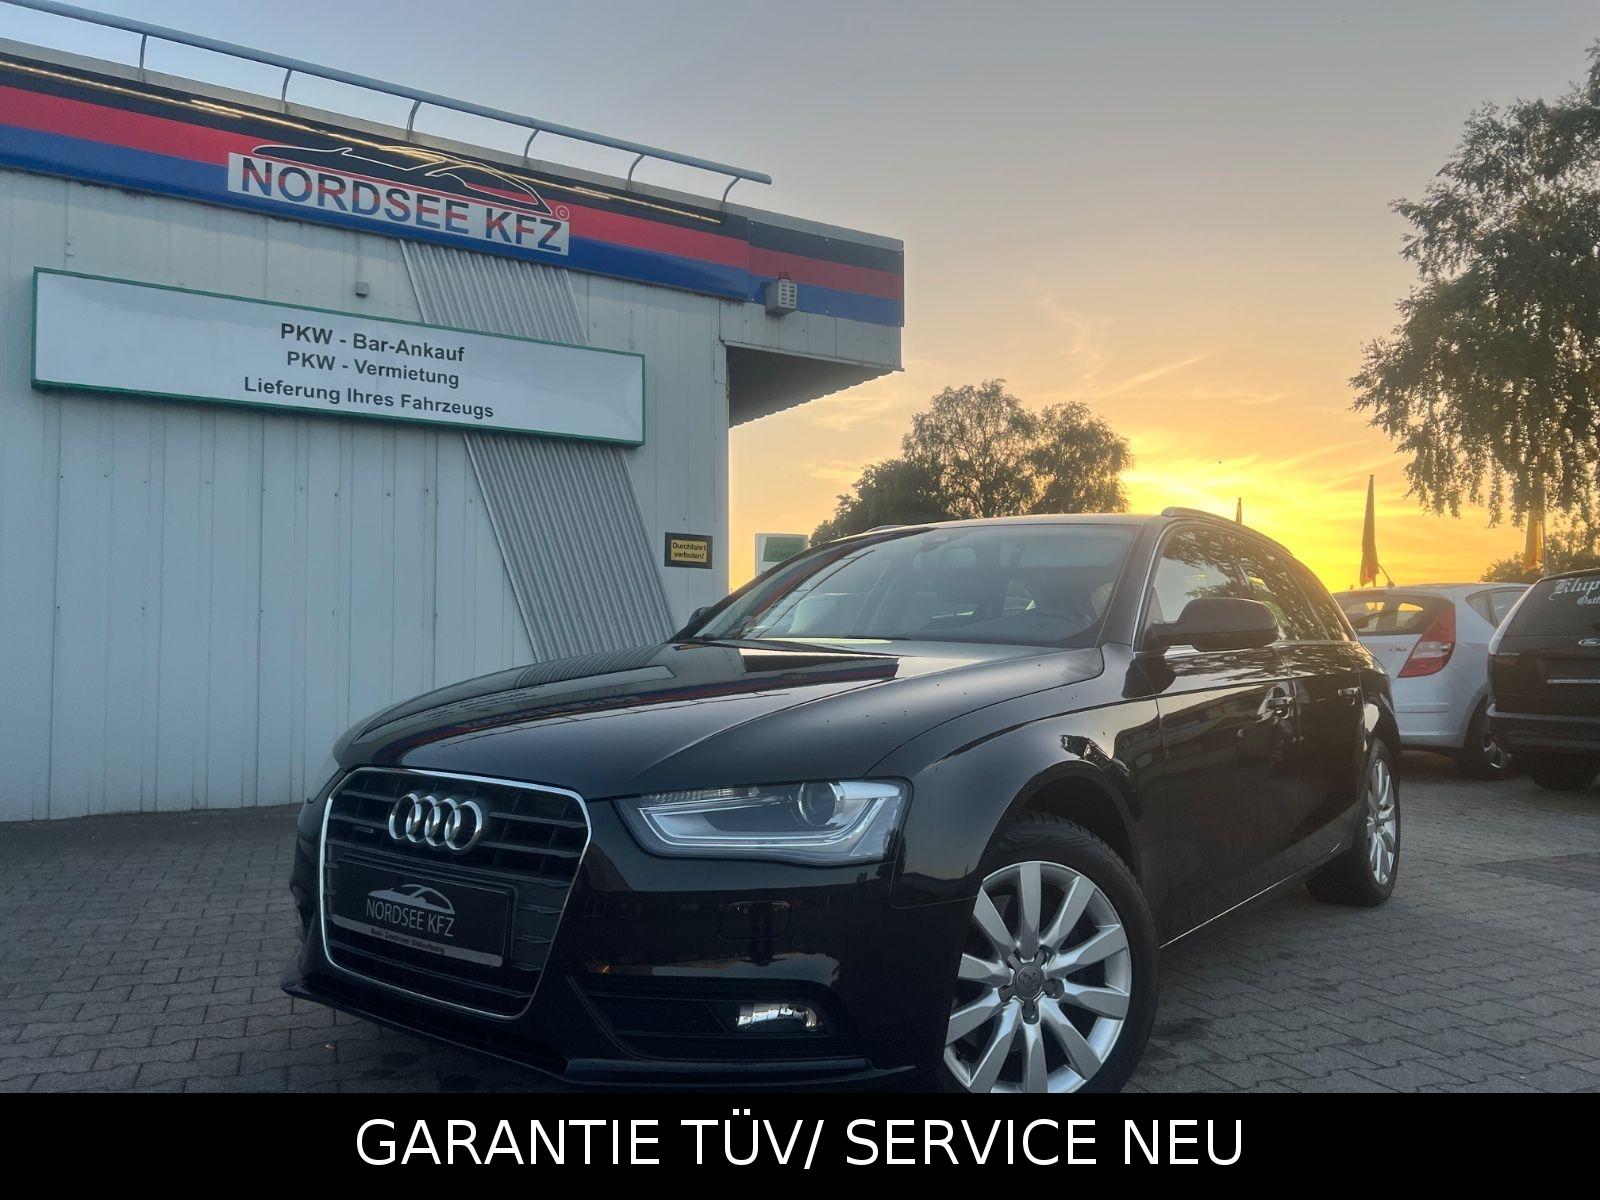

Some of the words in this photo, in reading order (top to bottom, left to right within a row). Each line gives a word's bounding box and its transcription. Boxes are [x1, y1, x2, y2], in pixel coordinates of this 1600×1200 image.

[241, 157, 470, 234] NORDSEE
[485, 207, 562, 251] KFZ
[280, 322, 333, 345] PKW
[353, 333, 465, 362] Bar-Ankauf
[287, 350, 336, 371] PKW
[354, 359, 459, 389] Vermietung
[244, 376, 340, 405] Lieferung
[347, 387, 394, 407] Ihres
[401, 393, 494, 420] Fahrzeugs
[672, 541, 707, 551] Durchfahrt
[674, 551, 705, 560] verboten!
[366, 899, 424, 930] NORDSEE
[427, 914, 454, 937] KFZ
